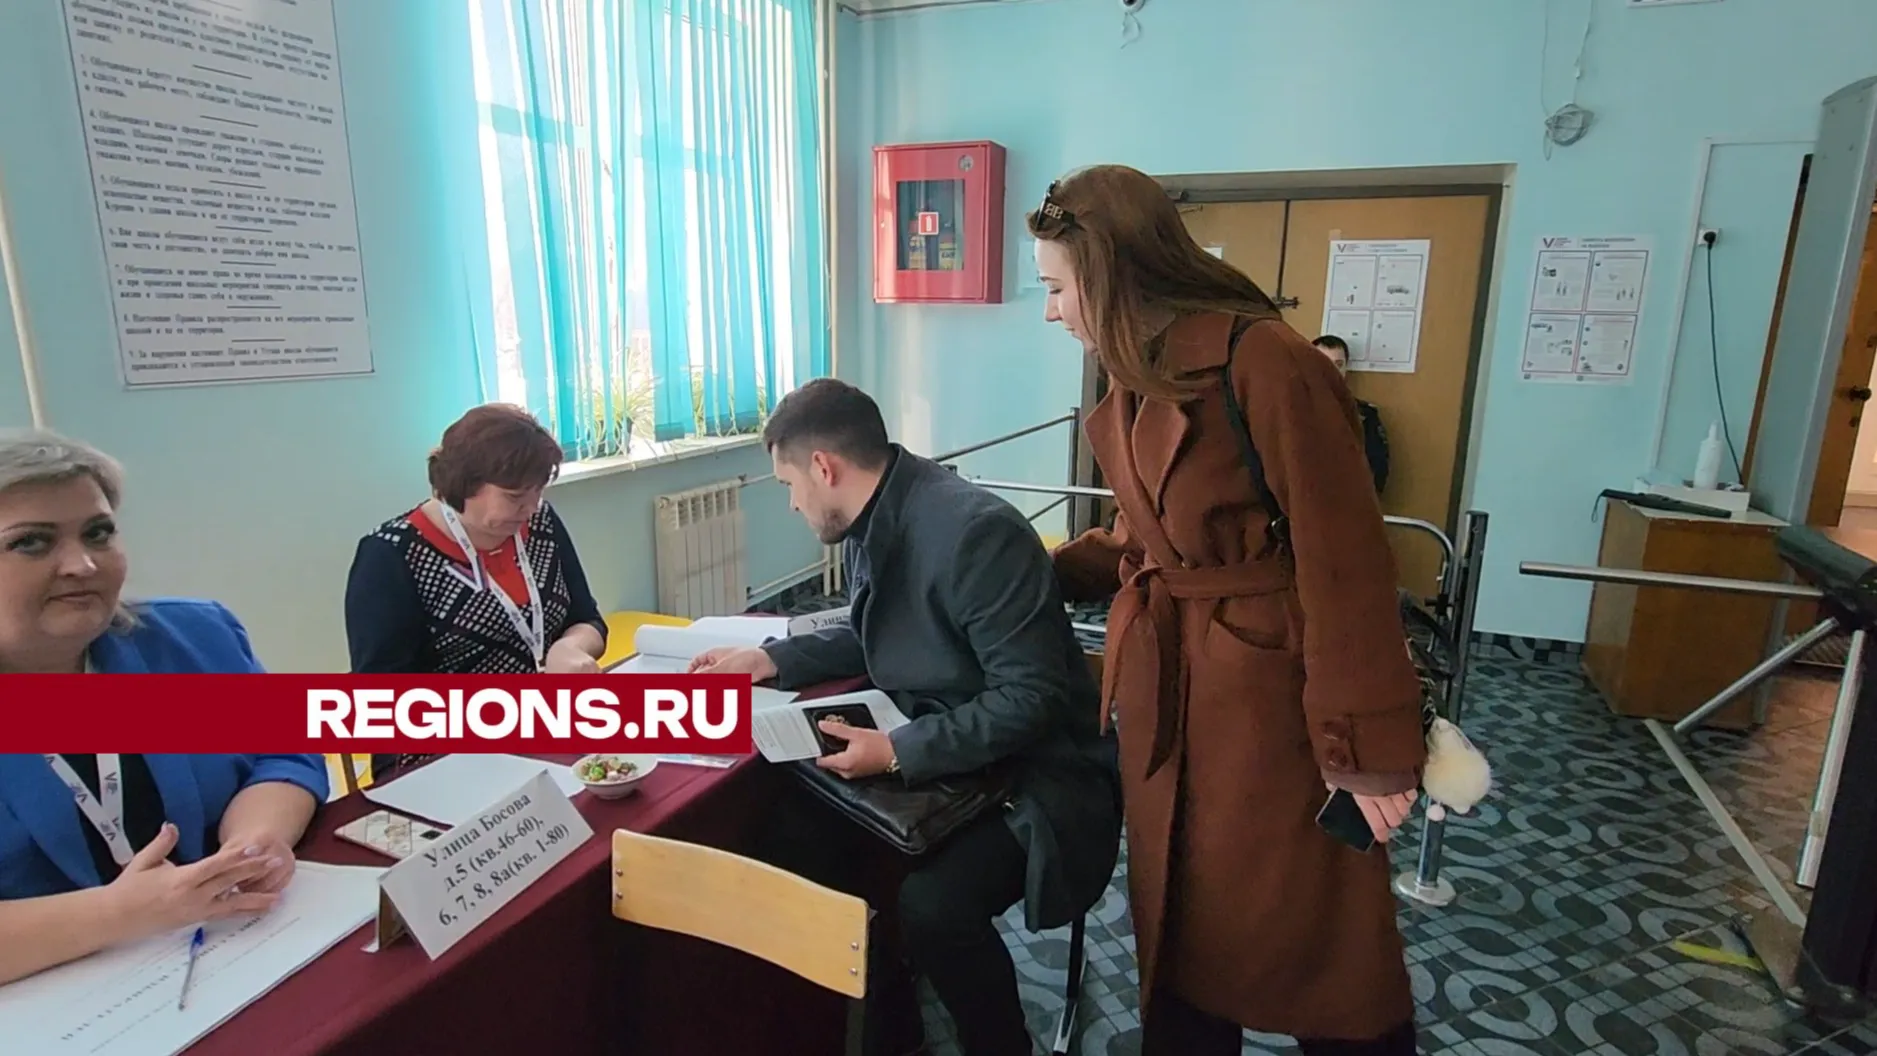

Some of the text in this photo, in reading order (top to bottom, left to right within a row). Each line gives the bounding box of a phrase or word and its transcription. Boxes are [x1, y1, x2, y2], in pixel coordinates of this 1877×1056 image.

[424, 794, 532, 868] Улица Босова
[438, 823, 570, 926] 6, 7, 8, 8а(кв. 1-80)
[444, 863, 469, 893] д.5
